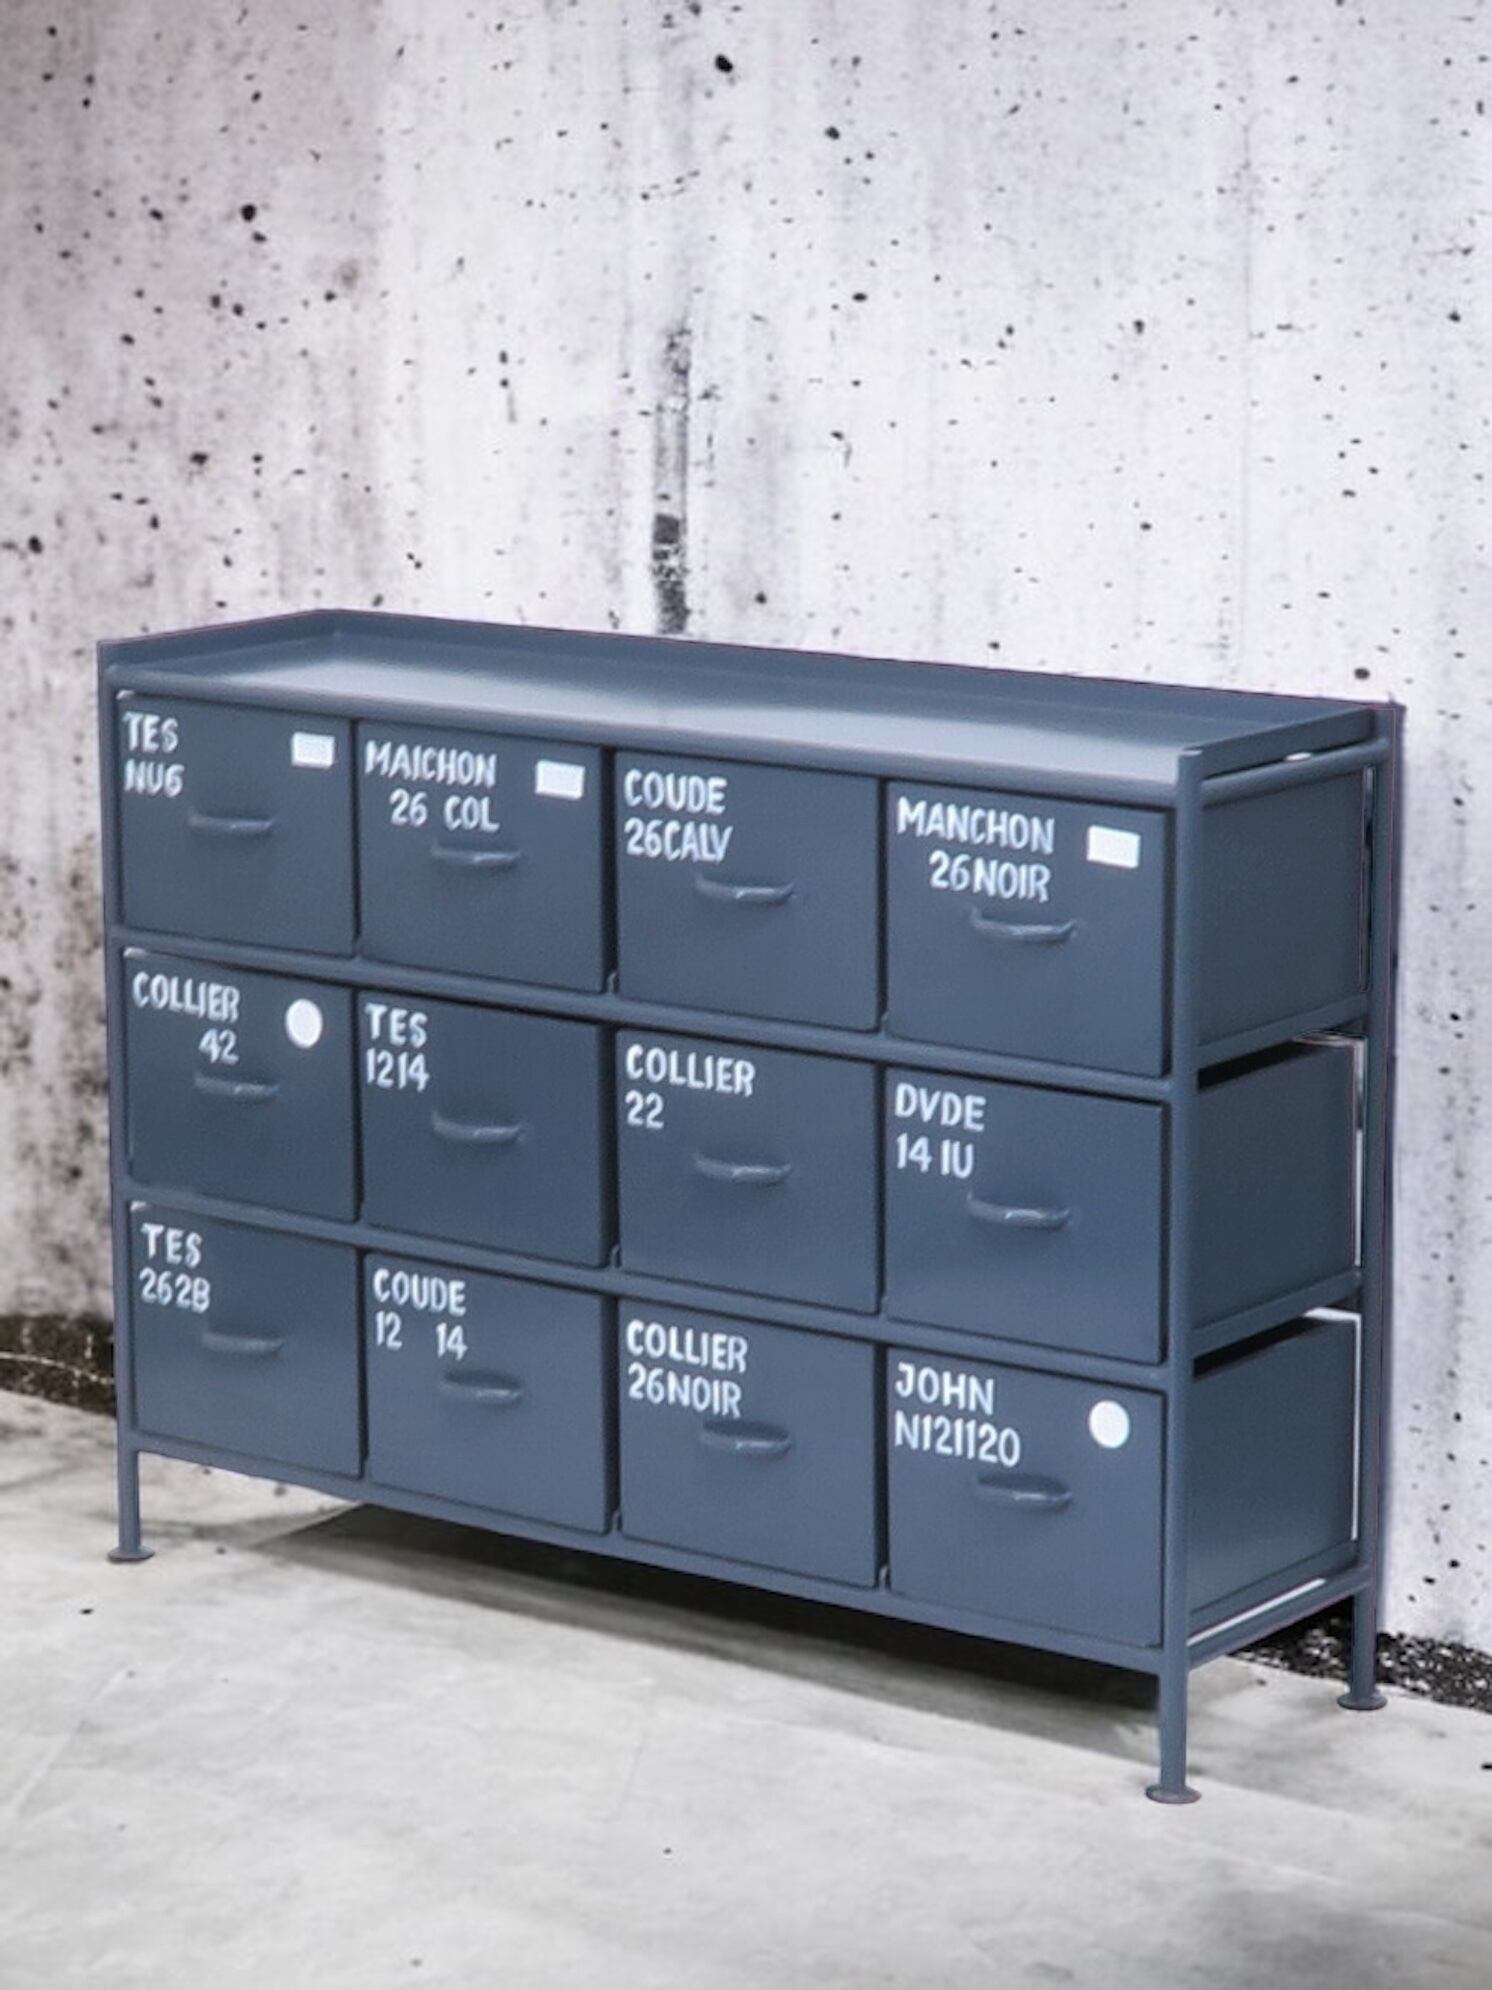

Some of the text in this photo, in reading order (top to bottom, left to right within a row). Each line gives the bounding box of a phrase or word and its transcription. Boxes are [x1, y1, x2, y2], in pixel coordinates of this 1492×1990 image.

[124, 711, 178, 753] TES
[389, 788, 499, 832] 26 COL
[624, 768, 728, 815] COUDE
[897, 796, 1055, 855] MANCHON
[133, 971, 240, 1022] COLLIER
[199, 1028, 238, 1063] 42
[365, 1003, 427, 1048] TES
[366, 1047, 430, 1091] 1214
[625, 1043, 756, 1097] COLLIER
[625, 1089, 664, 1129] 22
[896, 1132, 932, 1172] 14
[141, 1222, 202, 1268] TES
[373, 1268, 466, 1316] COUDE
[376, 1310, 468, 1360] 12 14
[626, 1319, 748, 1374] COLLIER
[627, 1361, 742, 1418] 26NOIR
[895, 1361, 994, 1416] JOHN
